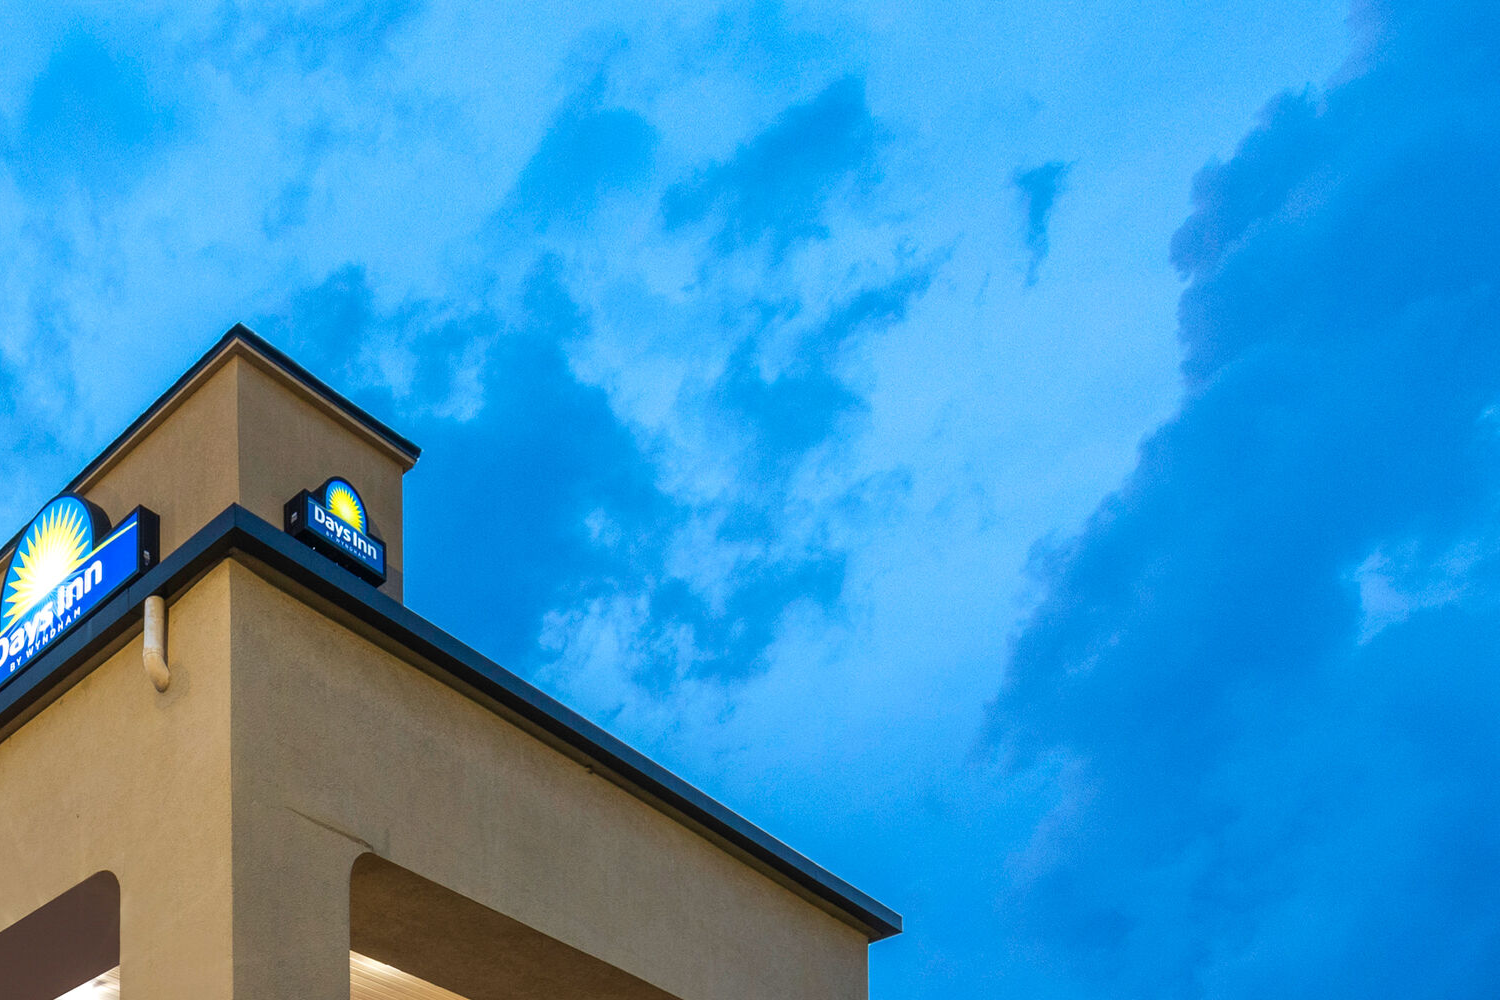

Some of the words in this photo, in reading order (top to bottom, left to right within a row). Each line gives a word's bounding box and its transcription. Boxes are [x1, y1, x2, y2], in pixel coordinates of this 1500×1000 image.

[315, 505, 351, 542] Days
[353, 532, 377, 560] Inn
[57, 560, 103, 615] Inn
[10, 656, 22, 672] BY
[26, 606, 81, 658] WYNDHAM
